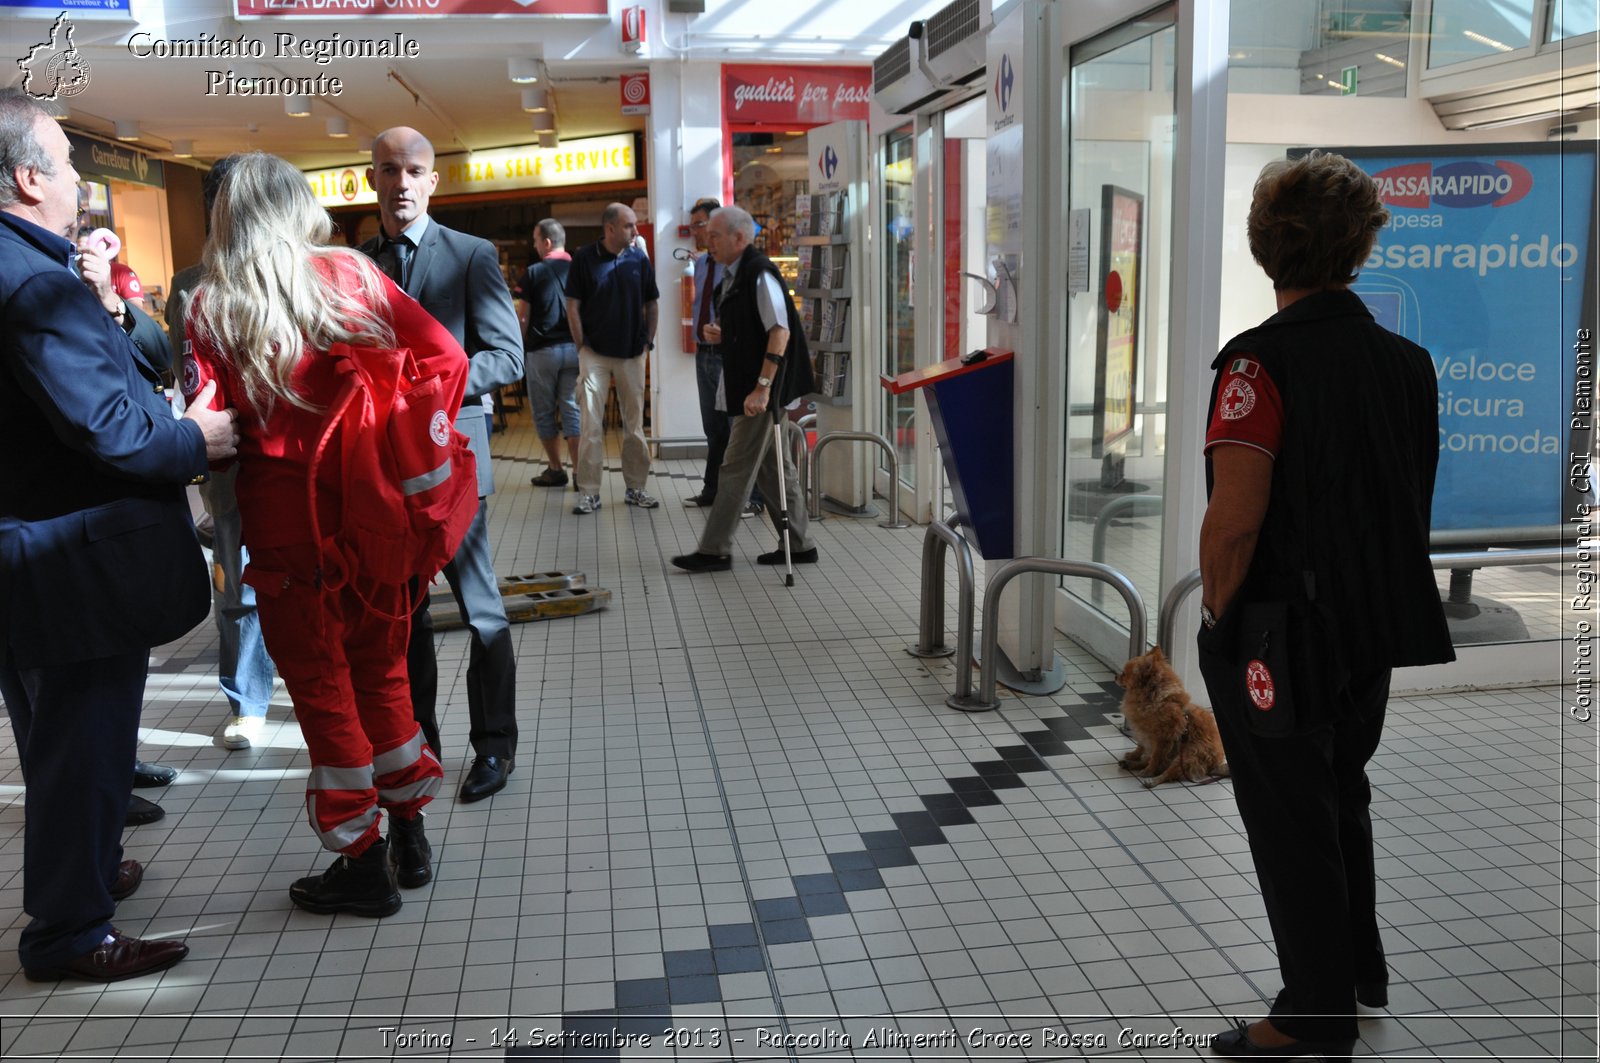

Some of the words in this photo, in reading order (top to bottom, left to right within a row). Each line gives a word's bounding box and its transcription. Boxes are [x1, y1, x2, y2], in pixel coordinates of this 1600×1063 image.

[734, 75, 795, 111] qualità
[799, 82, 829, 108] per
[92, 144, 130, 171] Carrefour
[448, 162, 495, 183] PIZZA
[505, 157, 543, 178] SELF
[554, 145, 632, 173] SERVICE
[1373, 174, 1513, 197] PASSARAPIDO
